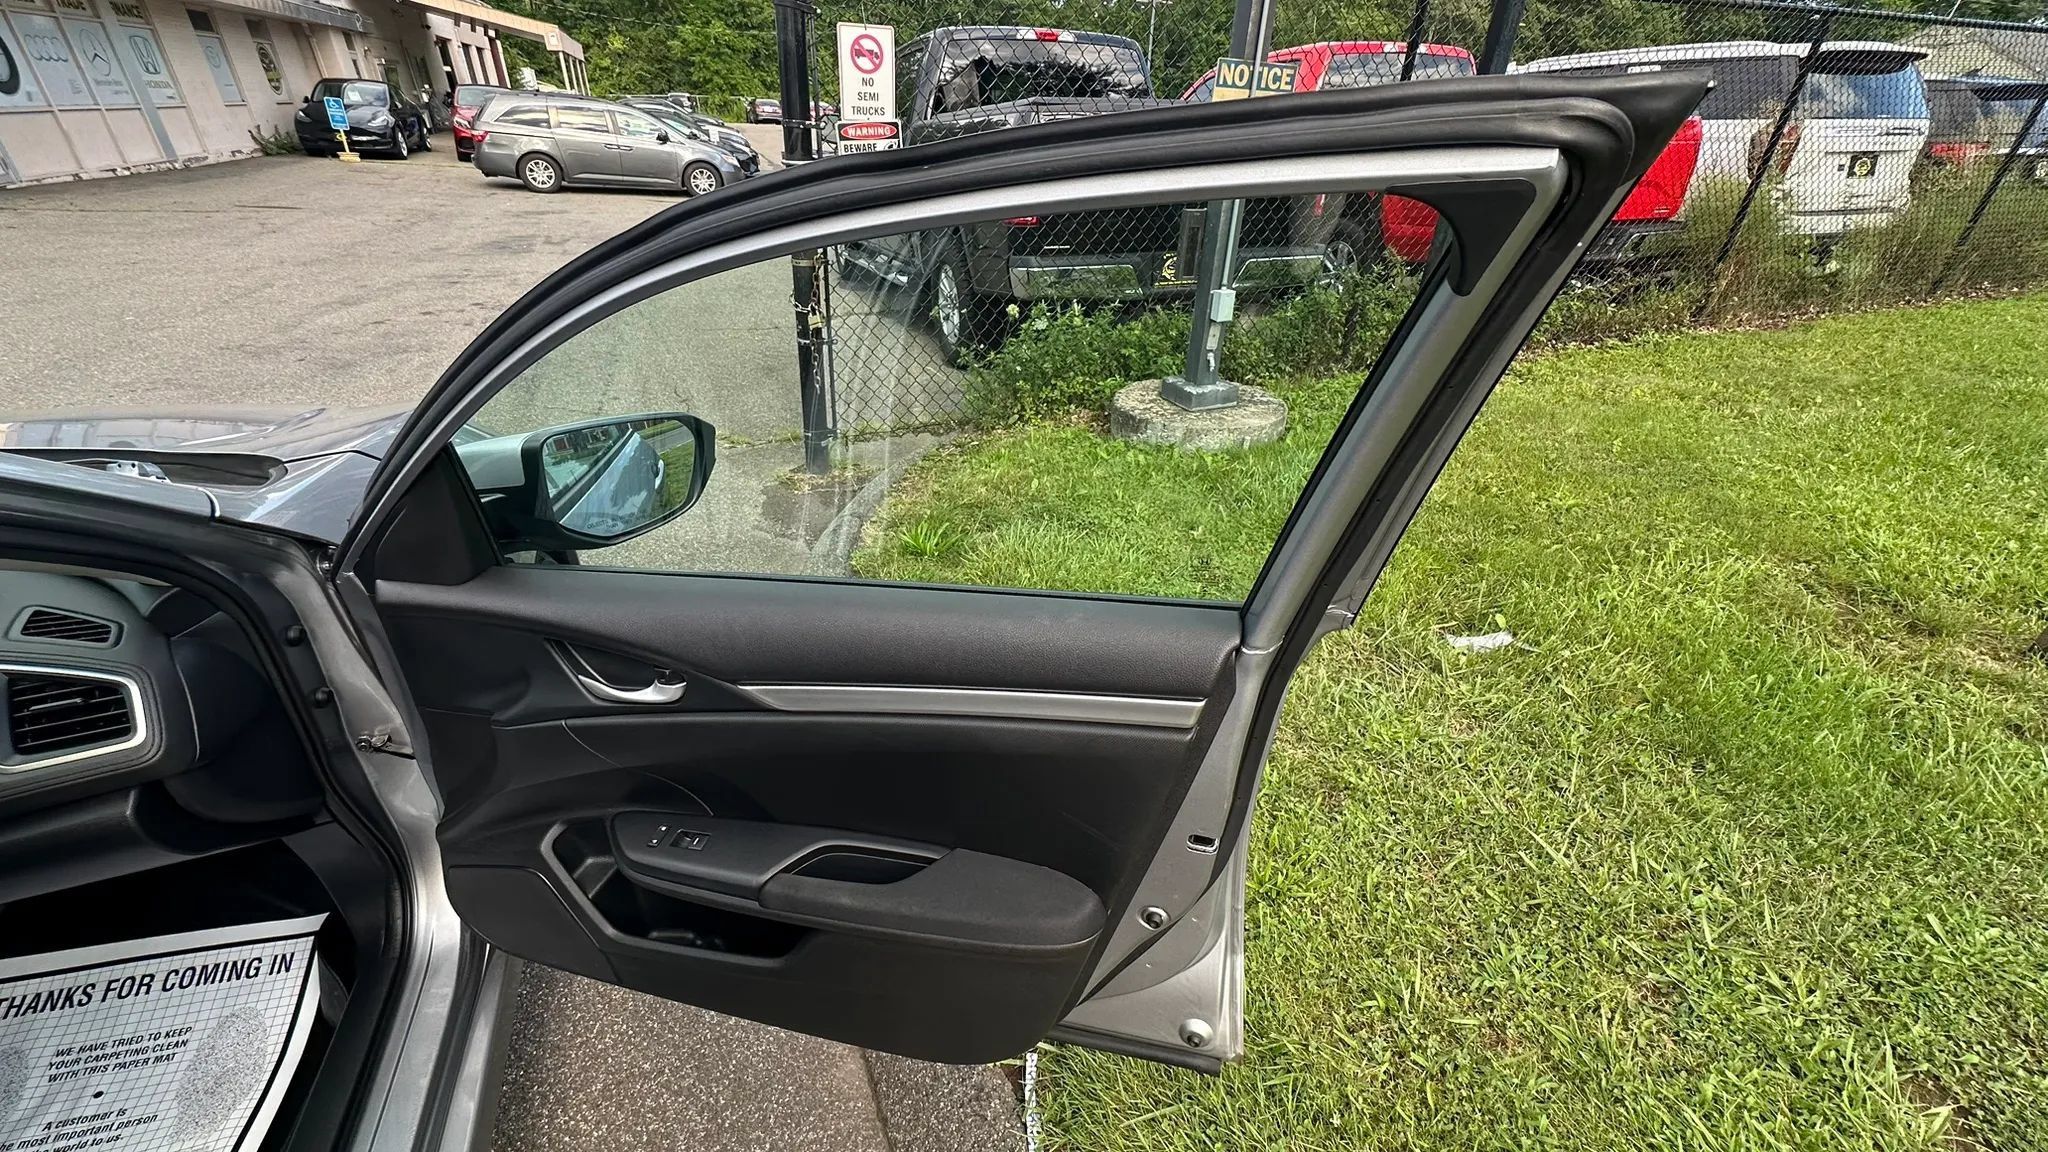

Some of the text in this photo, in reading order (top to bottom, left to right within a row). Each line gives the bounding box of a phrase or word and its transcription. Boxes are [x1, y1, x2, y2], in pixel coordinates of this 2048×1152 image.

[862, 77, 874, 87] NO
[1219, 62, 1294, 90] NOICE
[857, 91, 879, 102] SEMI
[851, 105, 885, 116] TRUCKS
[847, 125, 891, 137] WARNING
[843, 143, 877, 153] BEWARE
[101, 974, 155, 1003] FOR
[162, 957, 263, 993] COMING
[268, 952, 295, 976] IN
[55, 1026, 192, 1058] WE HAVE TRIED TO KEEP
[48, 1039, 189, 1071] YOUR CARPETING CLEAN
[48, 1052, 178, 1083] WITH THIS PAPER MAT
[0, 1113, 158, 1151] he most important person
[42, 1107, 128, 1132] A customer is
[90, 1136, 104, 1147] to
[106, 1133, 123, 1144] us.
